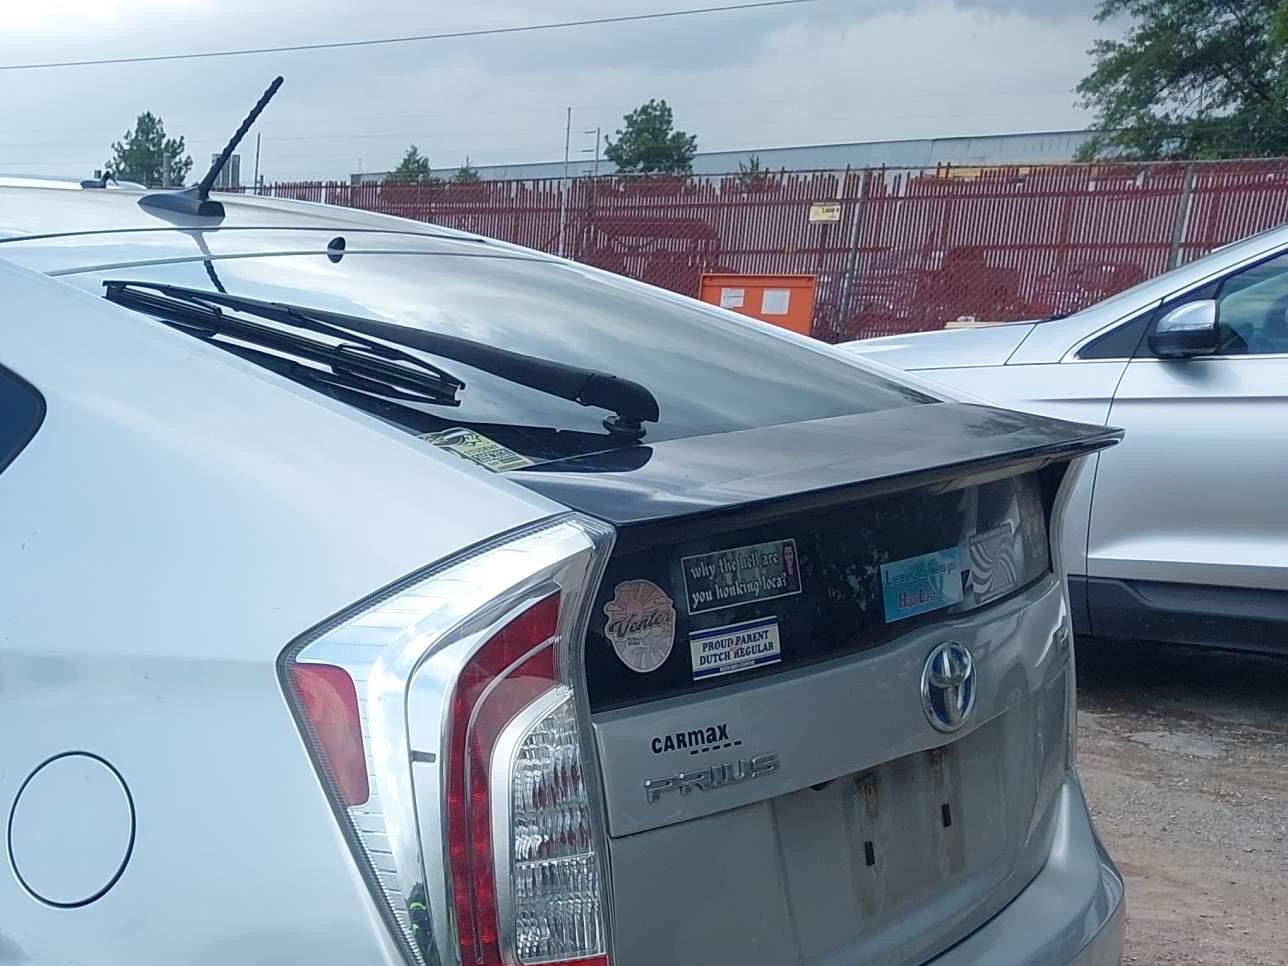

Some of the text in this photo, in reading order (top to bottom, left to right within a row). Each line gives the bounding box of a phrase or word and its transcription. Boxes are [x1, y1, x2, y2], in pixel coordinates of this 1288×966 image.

[691, 561, 716, 580] why
[719, 558, 736, 573] the
[762, 553, 778, 566] are
[692, 590, 713, 608] you
[715, 579, 760, 599] honking
[699, 641, 774, 666] DUTCH REGULAR
[702, 630, 770, 652] PROUD PARENT
[644, 752, 780, 803] PRIUS
